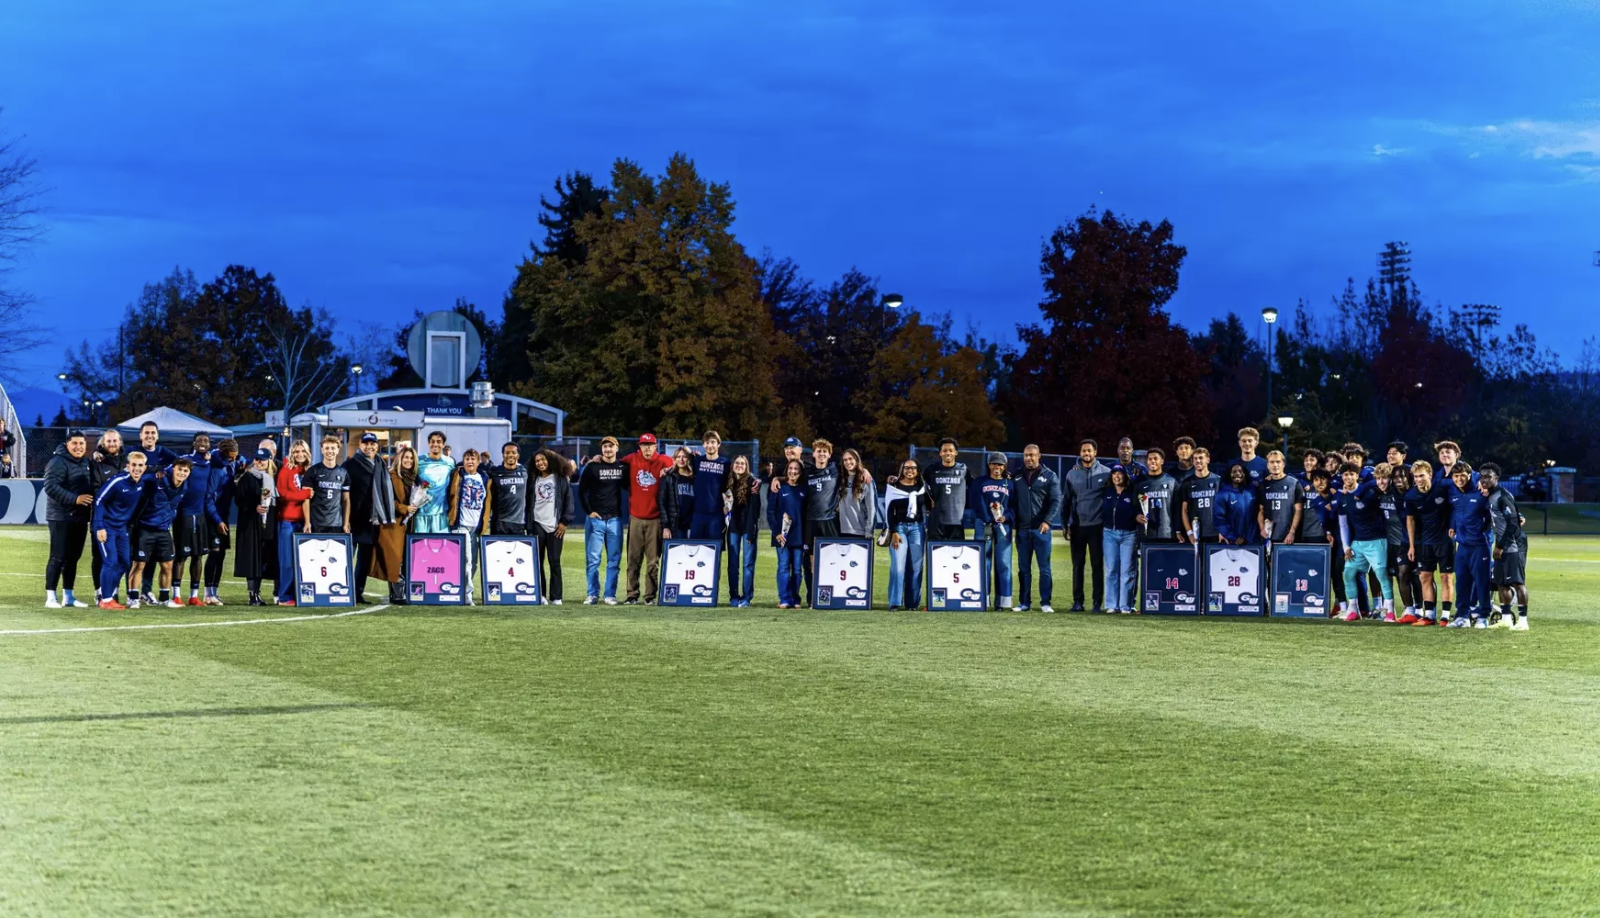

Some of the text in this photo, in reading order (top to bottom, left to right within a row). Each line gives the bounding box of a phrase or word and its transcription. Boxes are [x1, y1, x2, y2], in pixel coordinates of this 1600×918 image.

[700, 460, 724, 471] GONZAGA
[510, 484, 516, 494] 4
[816, 482, 822, 492] 9
[946, 484, 952, 494] 5
[327, 490, 333, 499] 6
[1192, 490, 1215, 498] GONZAGA
[1198, 498, 1210, 508] 28
[1272, 500, 1281, 510] 13
[321, 566, 327, 577] 6
[508, 566, 514, 577] 4
[685, 570, 695, 580] 19
[840, 570, 846, 580] 9
[434, 574, 437, 584] 1
[953, 572, 959, 583] 5
[1228, 576, 1240, 586] 28
[1166, 577, 1178, 589] 14
[1296, 579, 1308, 591] 13
